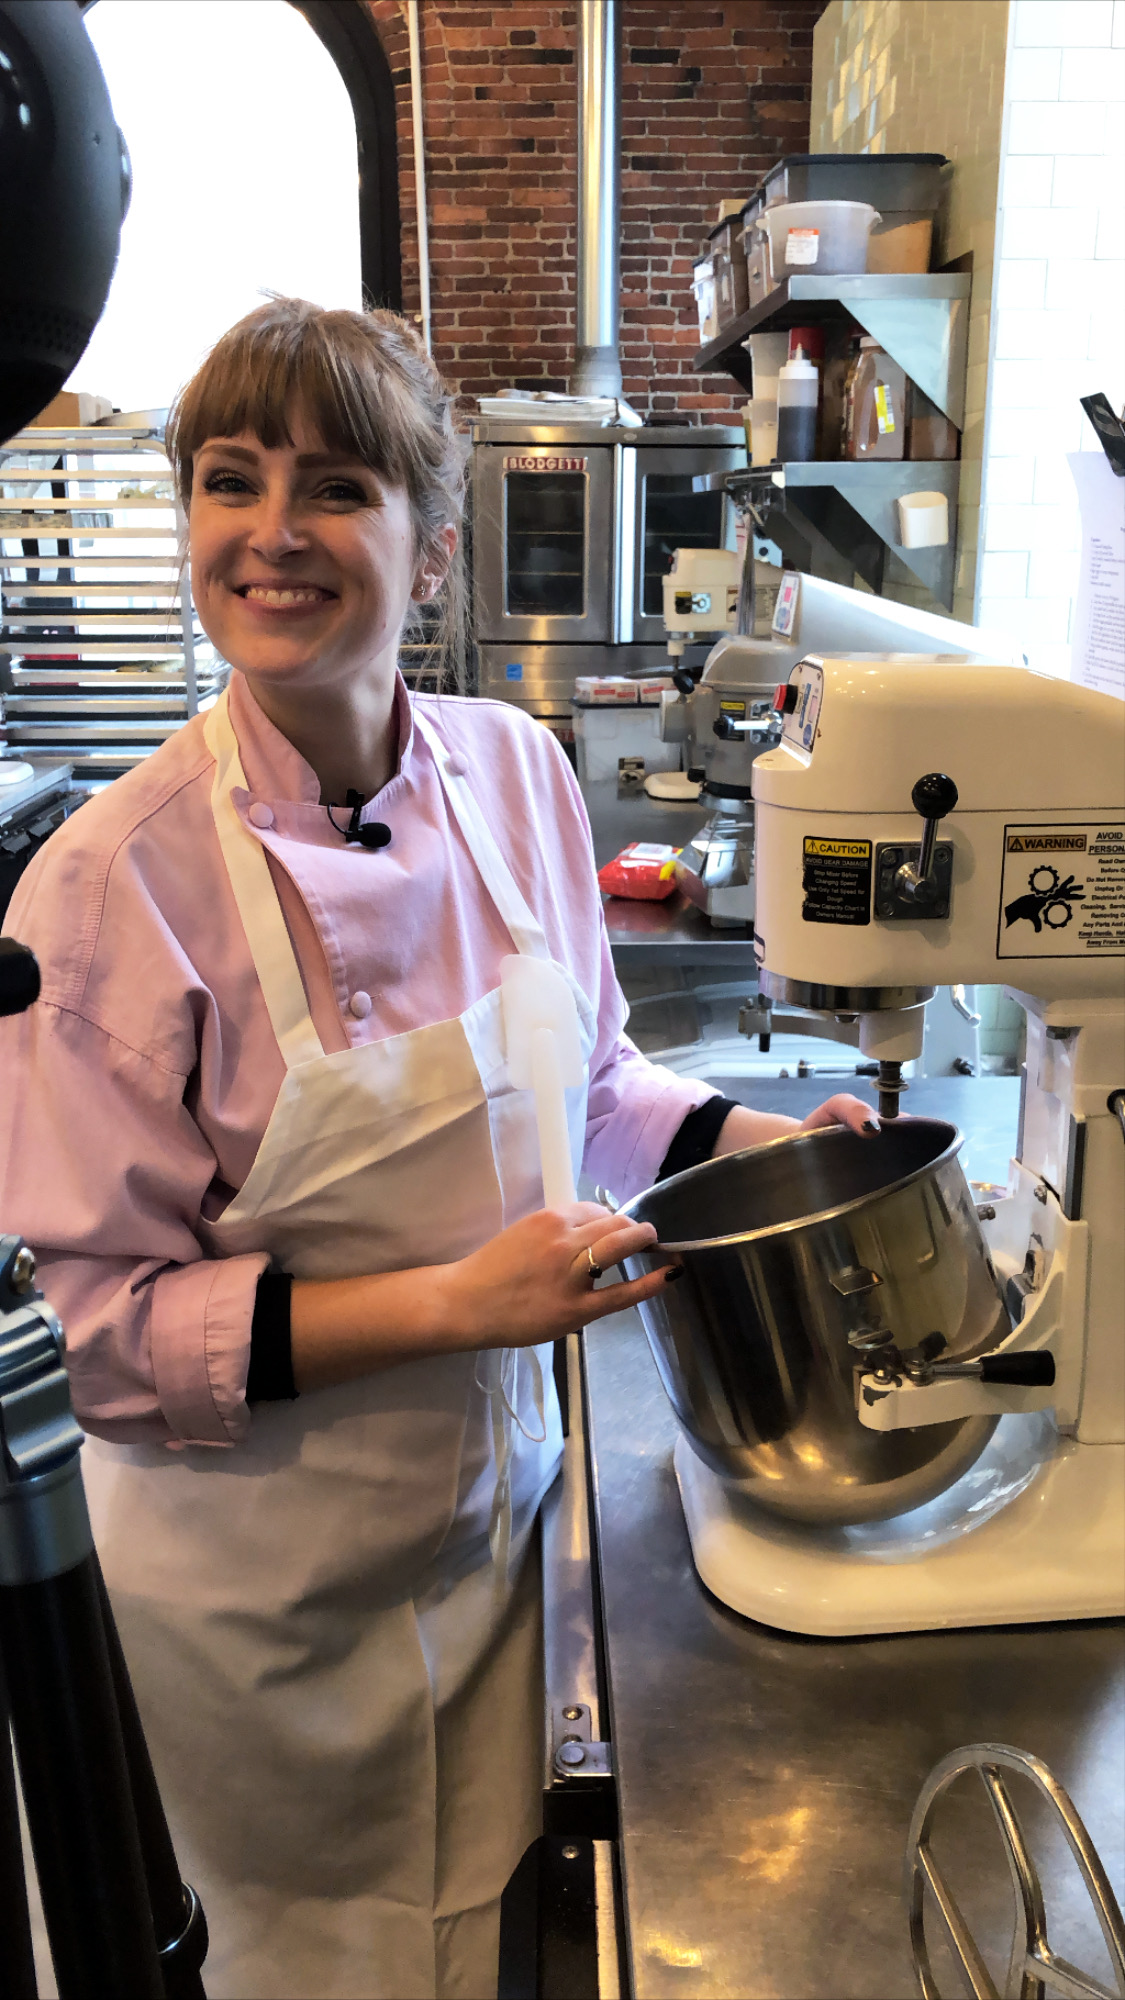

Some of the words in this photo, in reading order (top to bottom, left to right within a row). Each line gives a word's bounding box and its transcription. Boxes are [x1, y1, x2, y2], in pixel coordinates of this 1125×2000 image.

[509, 458, 581, 470] BLODGETT
[1096, 832, 1123, 840] AVOID
[1024, 838, 1084, 849] WARNING
[820, 844, 867, 854] CAUTION
